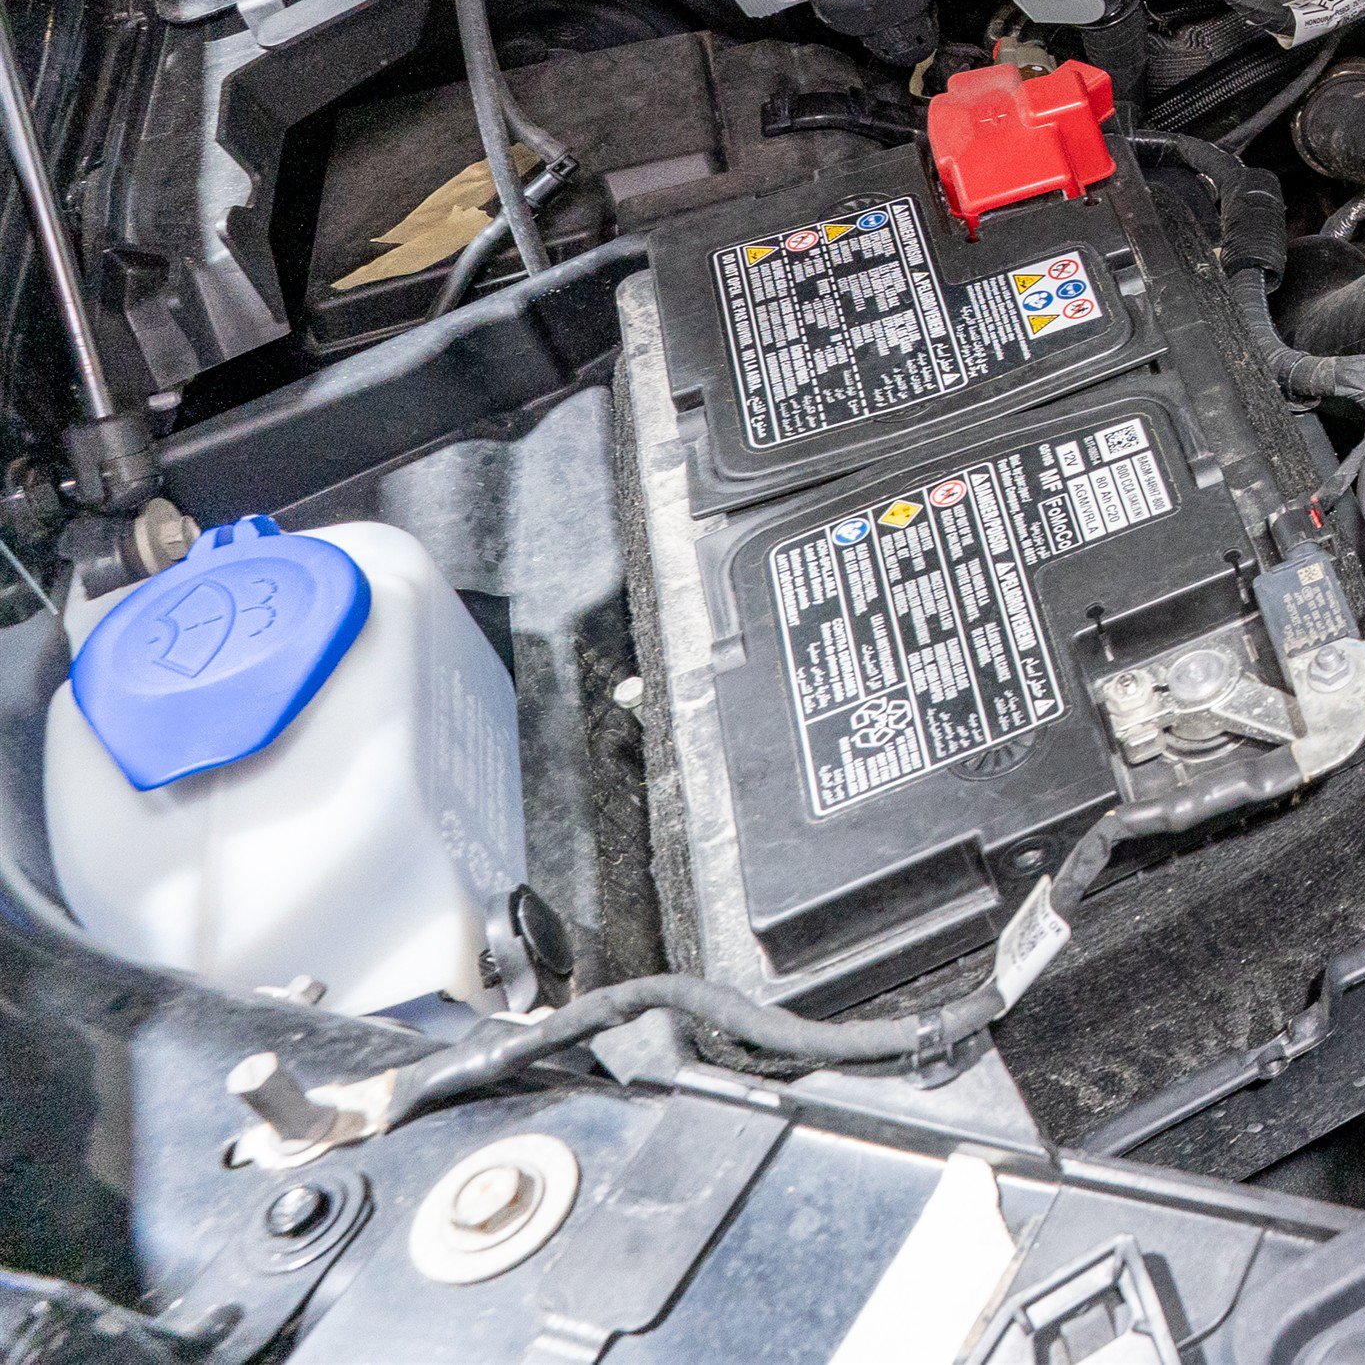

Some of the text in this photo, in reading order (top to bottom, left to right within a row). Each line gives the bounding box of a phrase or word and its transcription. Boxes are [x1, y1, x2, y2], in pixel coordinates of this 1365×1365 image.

[895, 210, 945, 338] DANGER/POISON PELIGRO/VENENO
[722, 253, 762, 393] DO NOT OPEN. NE PAS OUVRIR. NO LA ABRA.
[996, 458, 1010, 472] Ford
[1037, 467, 1063, 493] MF
[1062, 449, 1078, 467] 12V
[1072, 481, 1100, 534] AGM/VRLA
[1095, 475, 1121, 523] 80 Ah C20
[1115, 464, 1145, 520] 800 CCA (SAE/EN)
[1043, 497, 1076, 550] FoMoCo
[775, 552, 802, 628] ANTI DÉVERSEMENT
[802, 541, 826, 607] Lead Acid Battery
[814, 537, 839, 598] NON-SPILLABLE
[969, 482, 1010, 556] DANGER/POISON
[994, 571, 1037, 652] PELIGRO/VENENO
[869, 612, 884, 628] LEA
[872, 624, 887, 639] LAS
[830, 616, 858, 698] CONTRA DERRAMES
